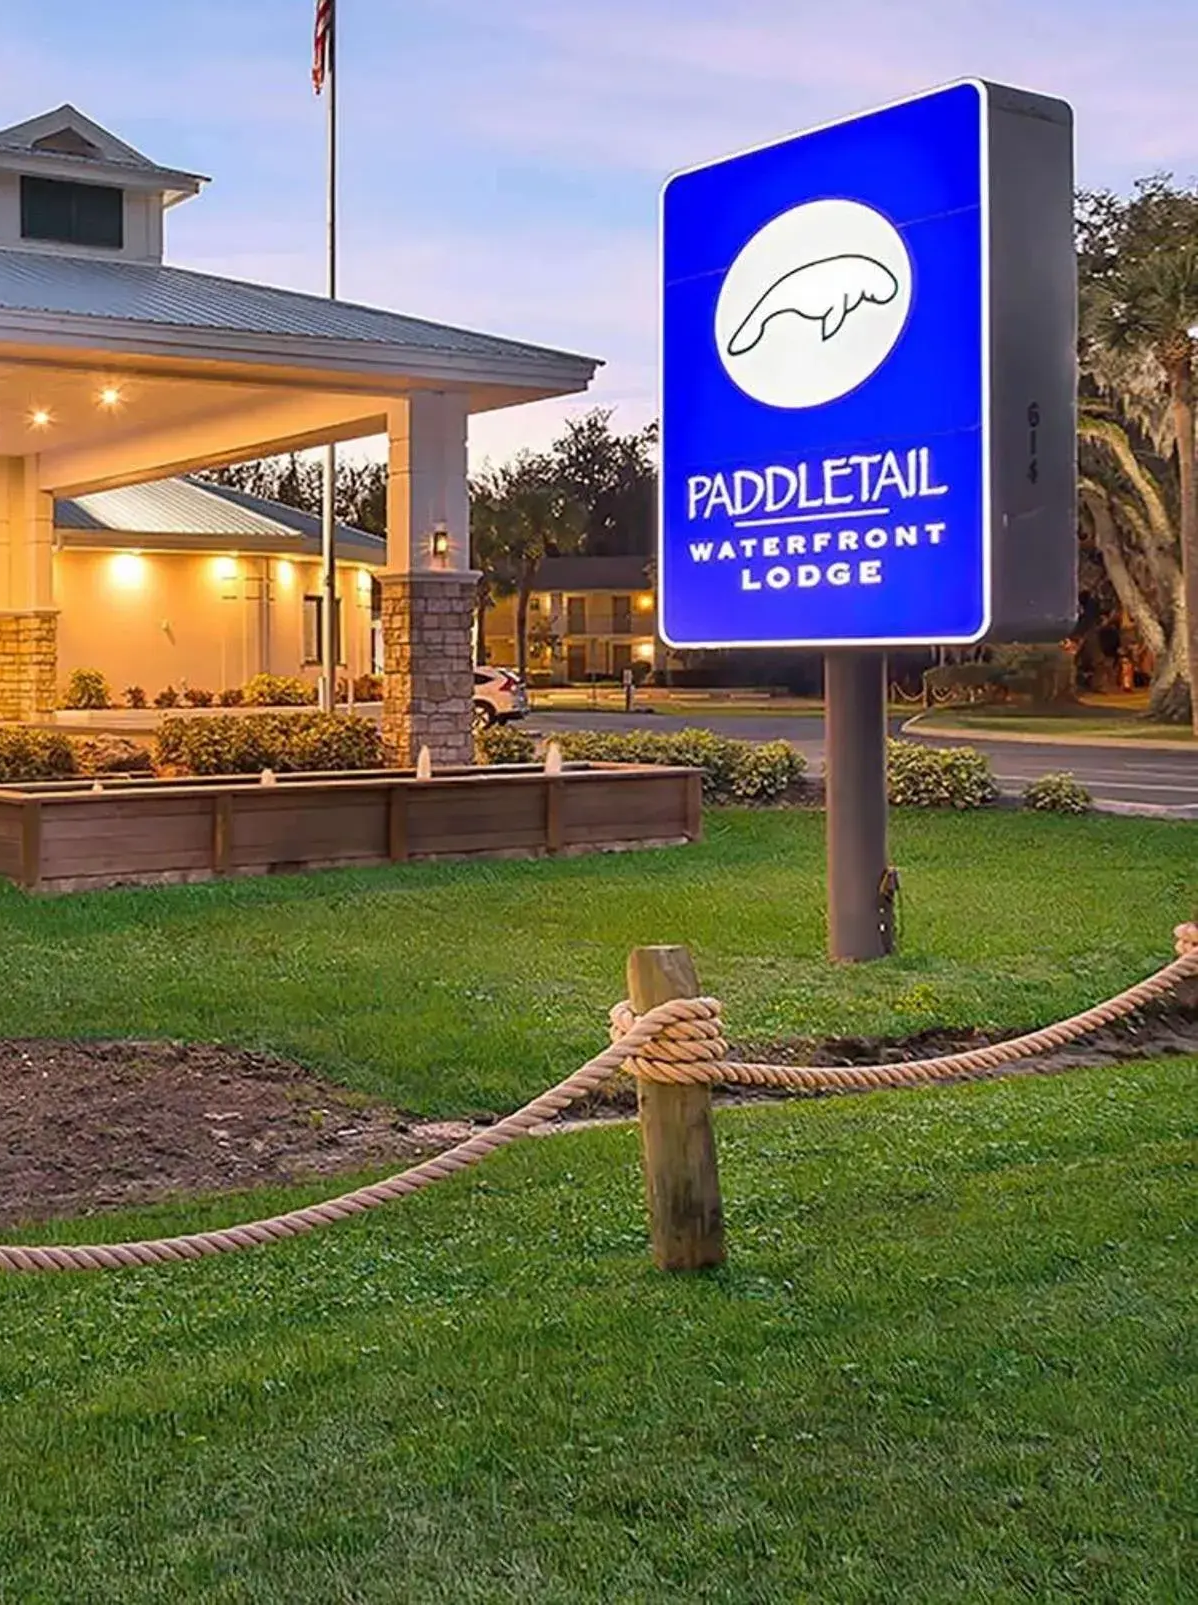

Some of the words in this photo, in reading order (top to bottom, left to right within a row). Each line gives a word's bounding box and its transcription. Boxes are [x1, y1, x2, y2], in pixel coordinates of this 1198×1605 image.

[687, 446, 949, 520] PADDLETAIL
[689, 522, 946, 562] WATERFRONT
[741, 560, 882, 591] LODGE
